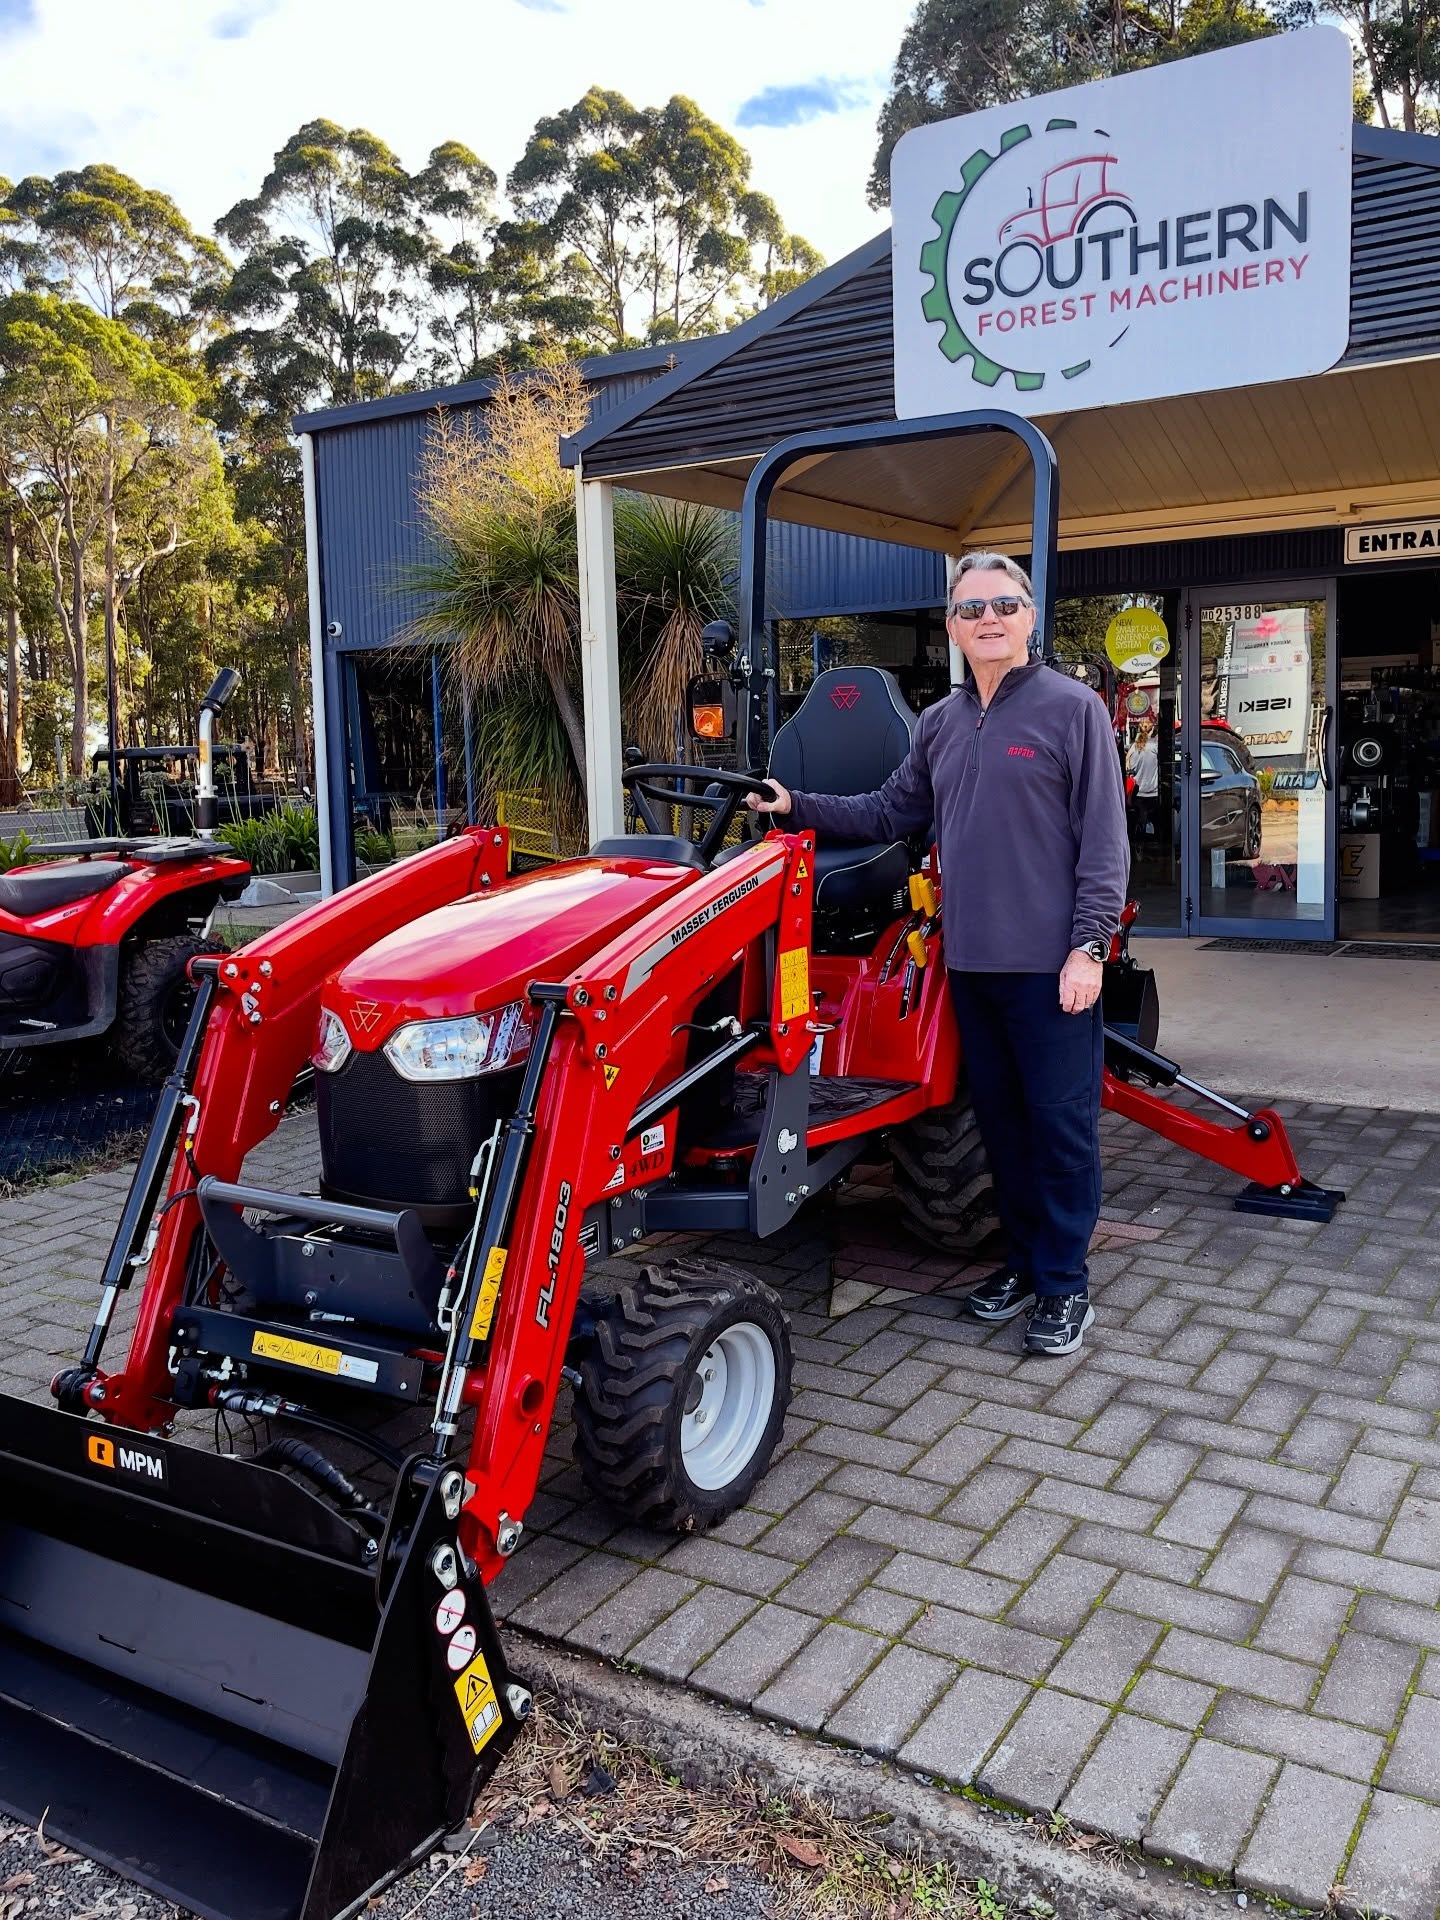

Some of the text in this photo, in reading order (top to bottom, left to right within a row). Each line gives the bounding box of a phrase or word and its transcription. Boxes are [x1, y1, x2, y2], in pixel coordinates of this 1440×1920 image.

[962, 191, 1308, 306] SOUTHERN
[978, 254, 1309, 337] FOREST MACHINERY
[1115, 625, 1140, 634] SMART
[1115, 632, 1150, 641] ANTENNA
[1115, 640, 1142, 649] SYSTEM
[1275, 774, 1304, 787] MTA
[670, 875, 759, 945] MASSEY FERGUSON
[630, 1152, 665, 1178] 4WD
[119, 1447, 163, 1480] MPM
